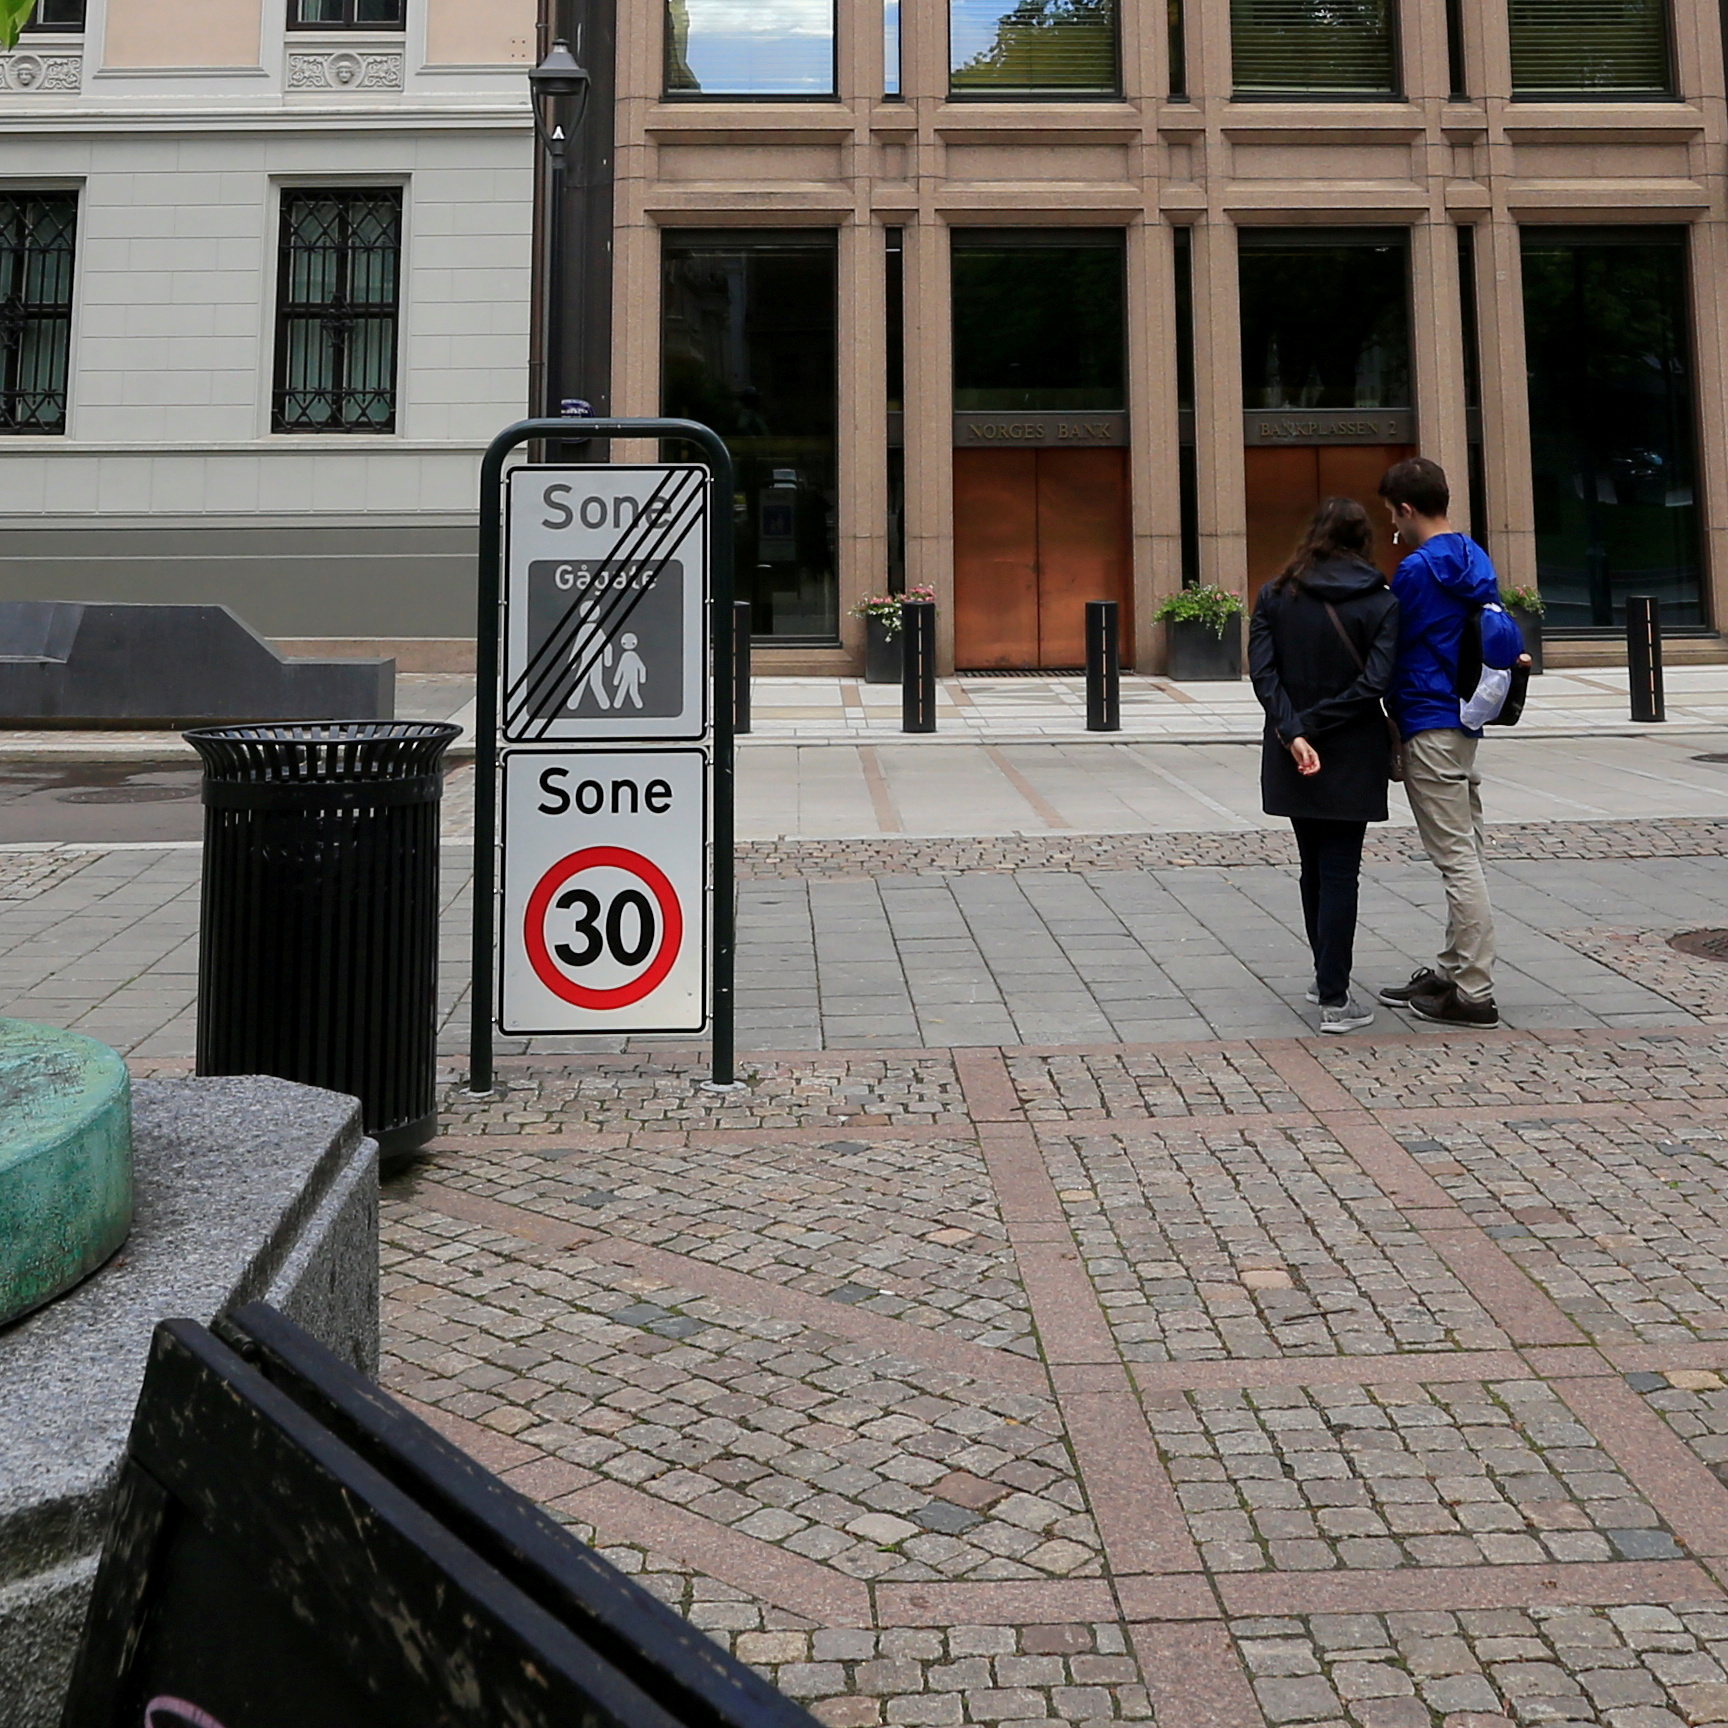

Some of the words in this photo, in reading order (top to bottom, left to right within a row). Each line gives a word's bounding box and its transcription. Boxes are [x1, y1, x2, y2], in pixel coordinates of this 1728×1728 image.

[968, 423, 1045, 439] NORGES
[1057, 423, 1112, 439] BANK
[1260, 421, 1379, 437] BANKPLASSEN
[1389, 420, 1398, 435] 2
[541, 483, 672, 530] Sone
[554, 564, 658, 596] Gågate
[537, 766, 674, 815] Sone
[554, 889, 655, 967] 30
